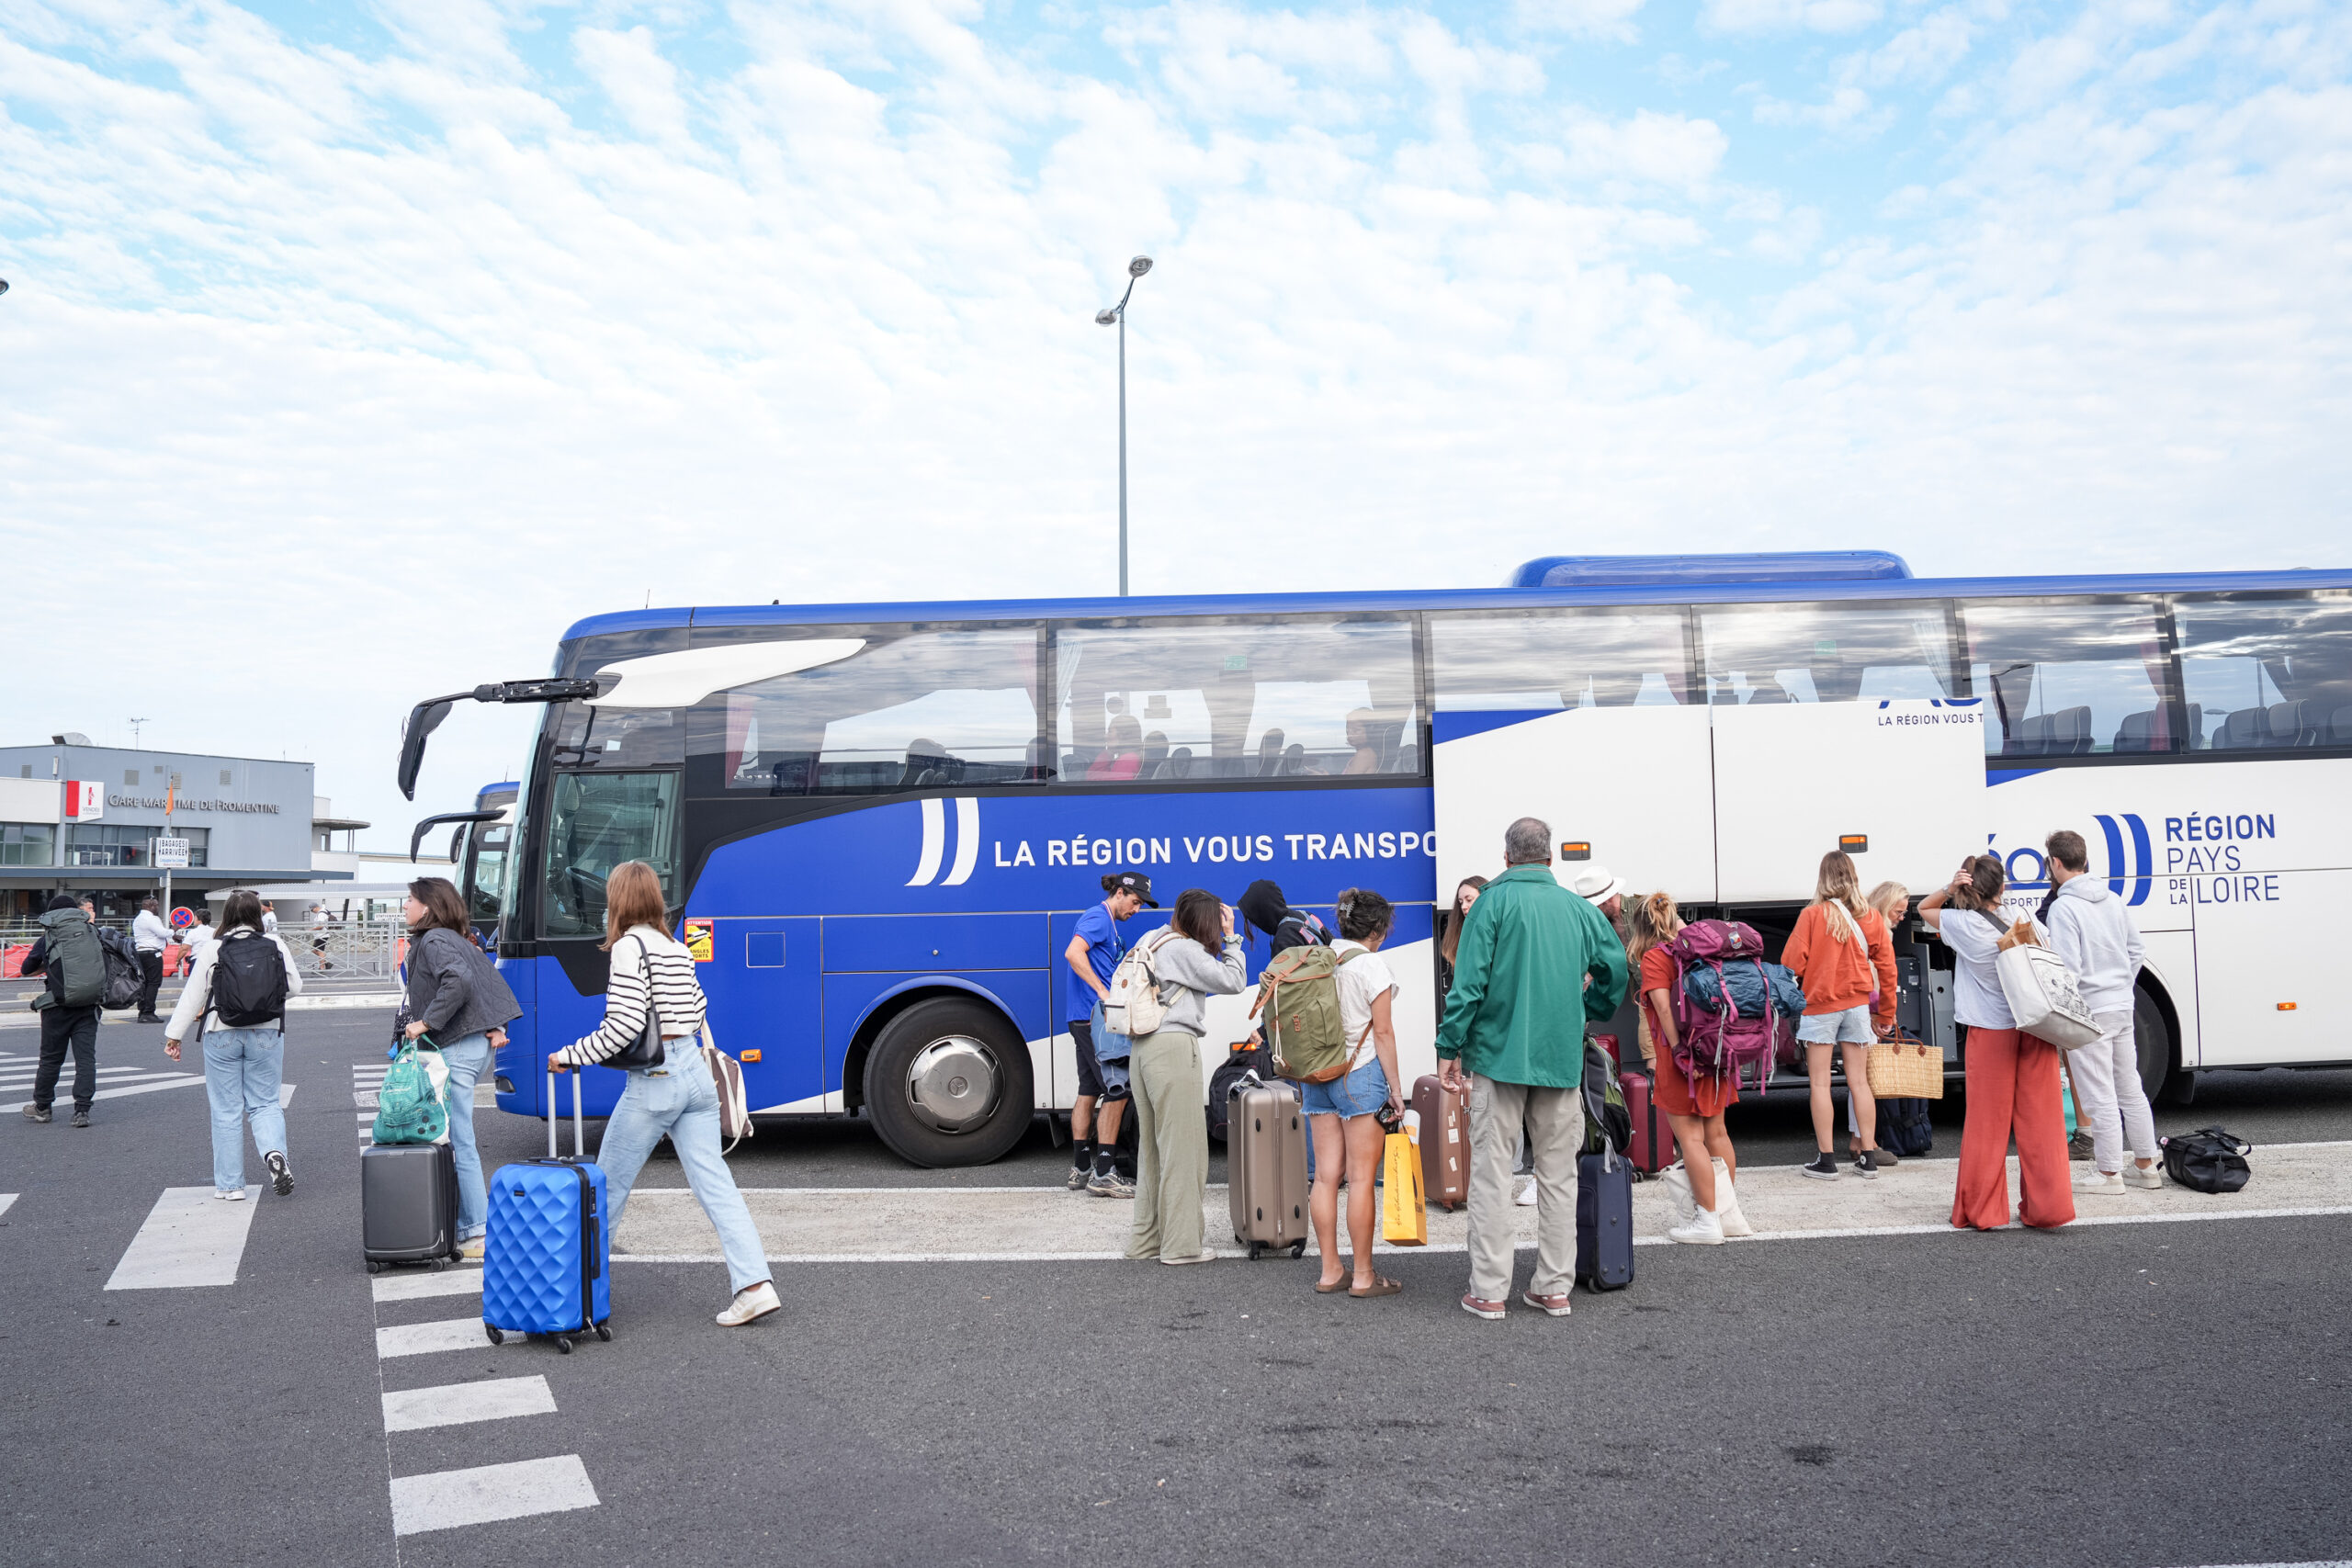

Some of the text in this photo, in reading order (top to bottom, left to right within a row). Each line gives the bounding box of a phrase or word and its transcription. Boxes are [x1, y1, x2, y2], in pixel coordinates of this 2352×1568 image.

[1878, 716, 1893, 726] LA
[1896, 714, 1939, 725] RÉGION
[1943, 714, 1974, 724] VOUS
[143, 797, 196, 810] MARTIME
[199, 800, 212, 810] DE
[215, 799, 279, 814] FROMENTINE
[2165, 811, 2275, 842] RÉGION
[161, 840, 186, 848] BAGAGES
[995, 840, 1035, 867] LA
[1047, 834, 1171, 866] RÉGION
[1182, 835, 1274, 863] VOUS
[2167, 845, 2241, 874] PAYS
[2169, 878, 2187, 890] DE
[2197, 874, 2279, 904] LOIRE
[2170, 894, 2188, 905] LA
